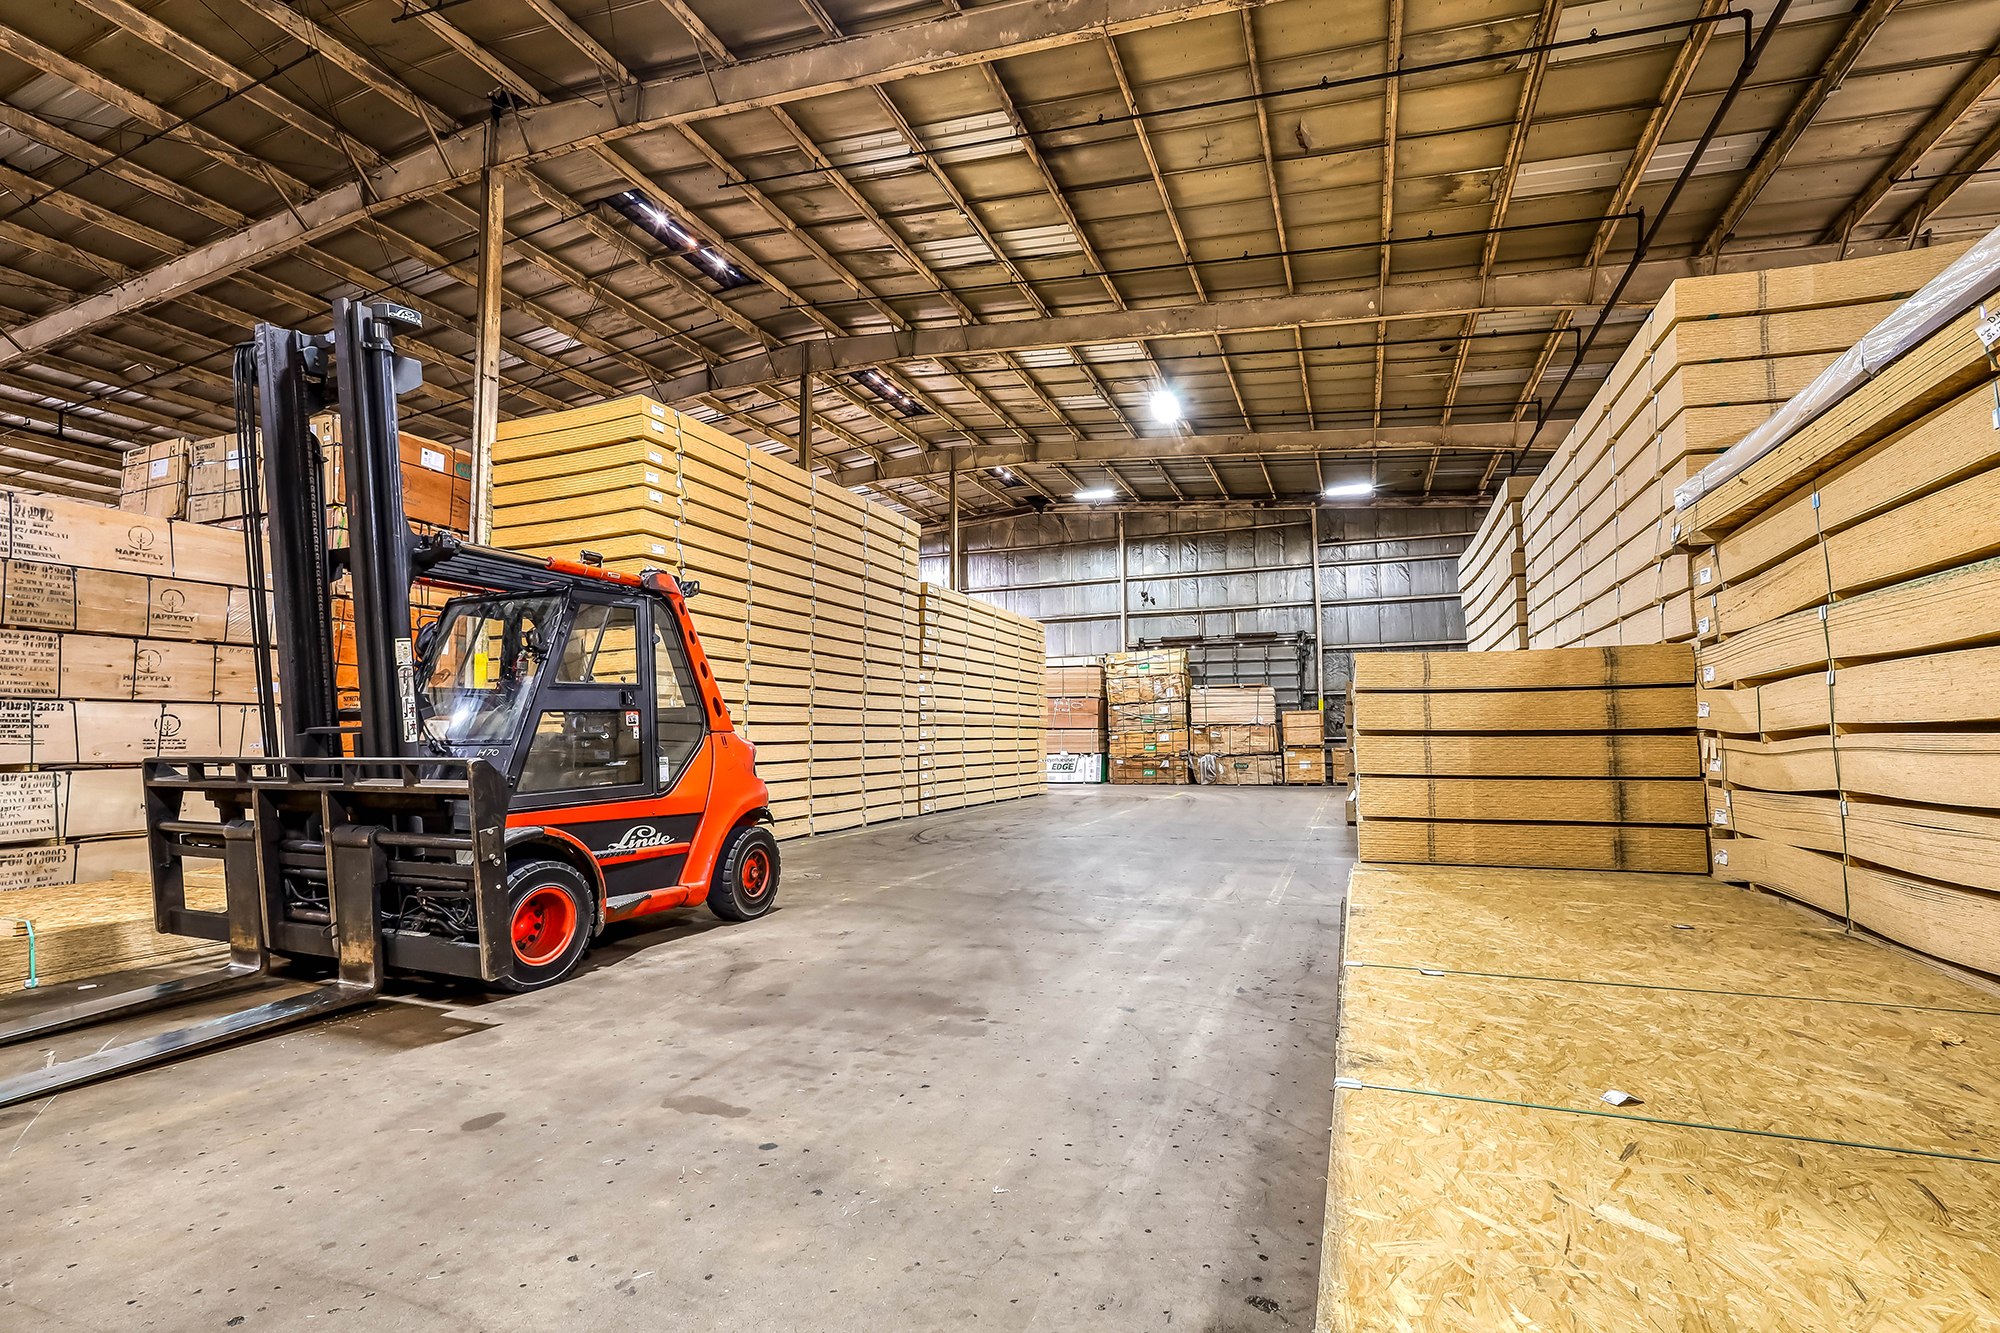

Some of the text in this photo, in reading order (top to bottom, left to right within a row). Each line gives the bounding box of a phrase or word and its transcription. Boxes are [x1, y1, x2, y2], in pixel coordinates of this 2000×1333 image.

[115, 548, 164, 561] HAPPYPLY
[1051, 762, 1075, 771] EDGE
[607, 824, 675, 850] Linde
